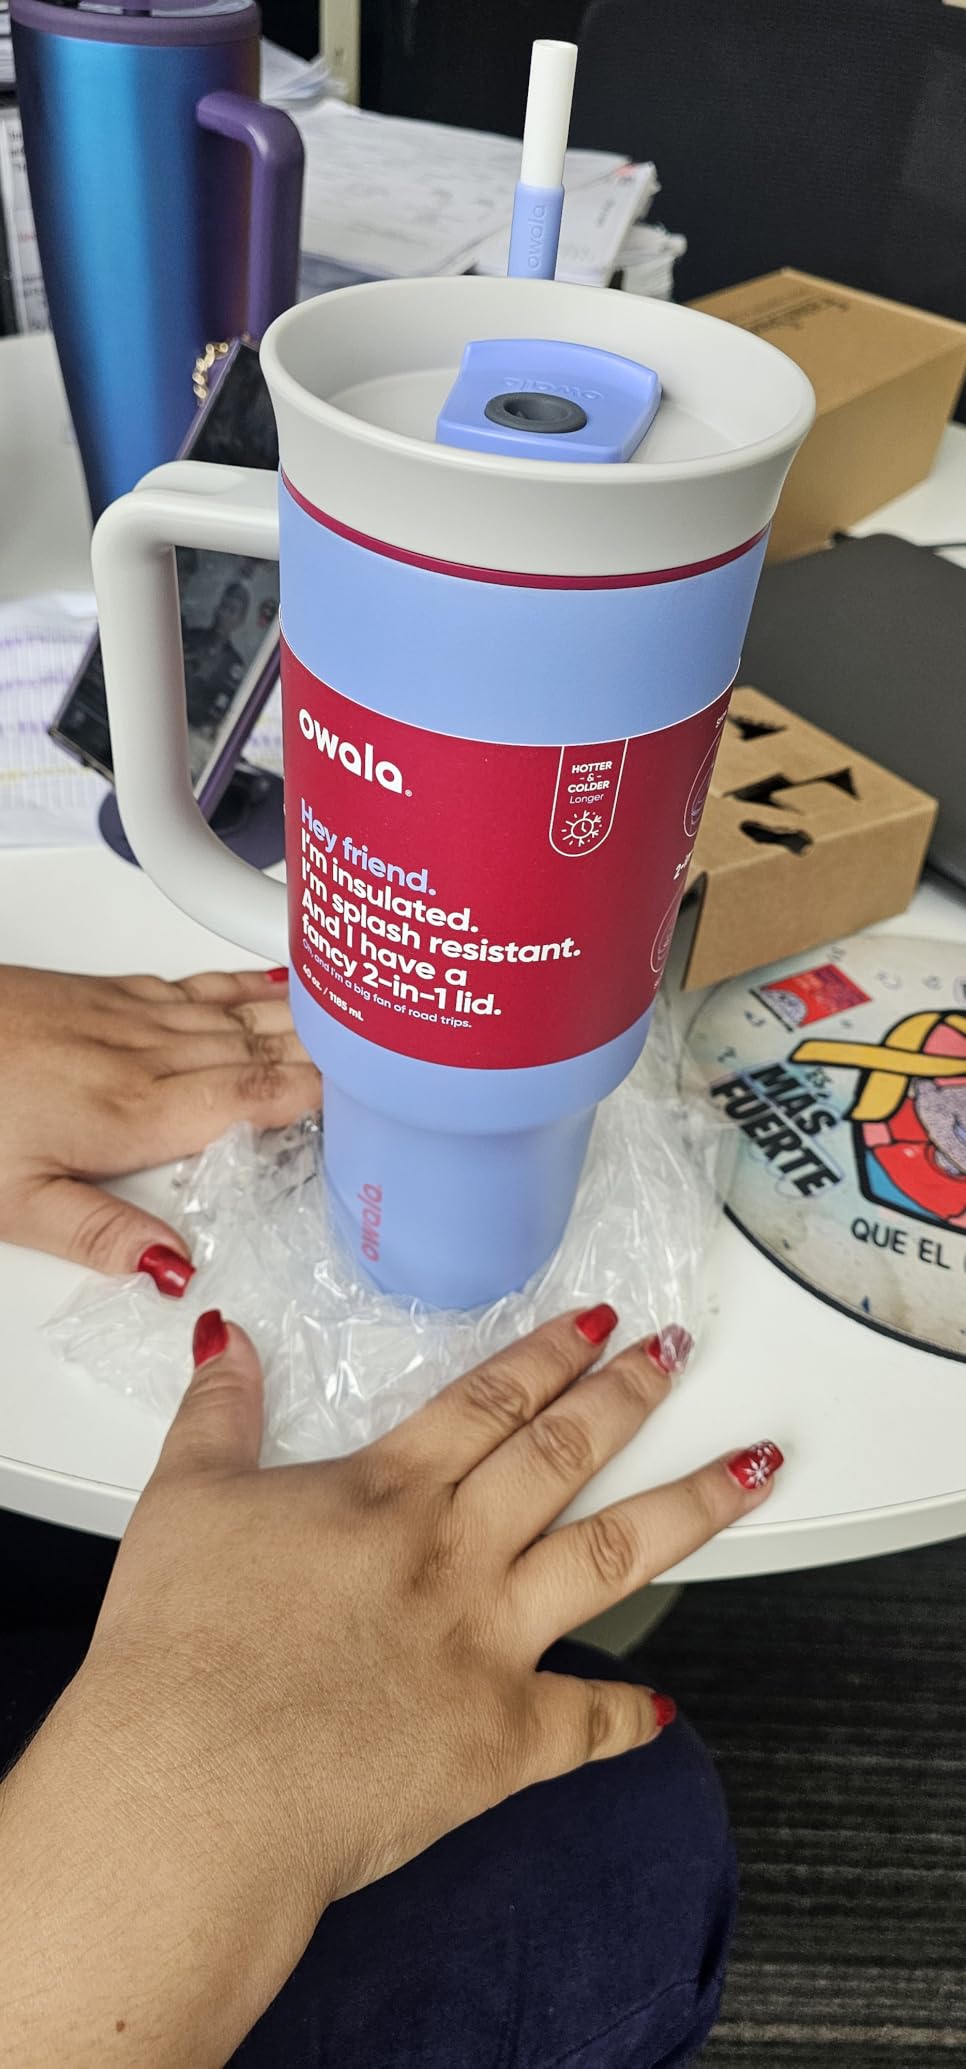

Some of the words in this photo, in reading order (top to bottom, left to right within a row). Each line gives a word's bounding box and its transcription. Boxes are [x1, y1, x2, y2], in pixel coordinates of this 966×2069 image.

[528, 204, 545, 270] owala
[567, 780, 610, 793] COLDER
[569, 793, 604, 804] Longer
[571, 760, 613, 774] HOTTER
[301, 797, 338, 853] Hey
[342, 836, 437, 896] friend.
[301, 827, 328, 875] I'm
[332, 857, 479, 933] insulated.
[301, 856, 328, 903] I'm
[331, 893, 421, 950] splash
[429, 936, 581, 963] resistant.
[301, 887, 340, 940] And
[346, 923, 354, 949] I
[360, 932, 436, 980] have
[444, 968, 468, 986] a
[302, 913, 358, 978] fancy
[362, 962, 447, 1010] 2-in-1
[455, 989, 502, 1016] lid.
[314, 954, 331, 973] and
[330, 967, 344, 984] I'm
[345, 979, 353, 990] a
[353, 983, 372, 1001] big
[373, 993, 392, 1009] fan
[393, 1003, 407, 1014] of
[408, 1008, 438, 1023] road
[440, 1015, 472, 1029] trips.
[328, 991, 348, 1011] 1185
[348, 1007, 364, 1022] mL
[711, 1079, 843, 1199] FUERTE
[851, 1217, 909, 1255] QUE
[918, 1238, 951, 1270] EL
